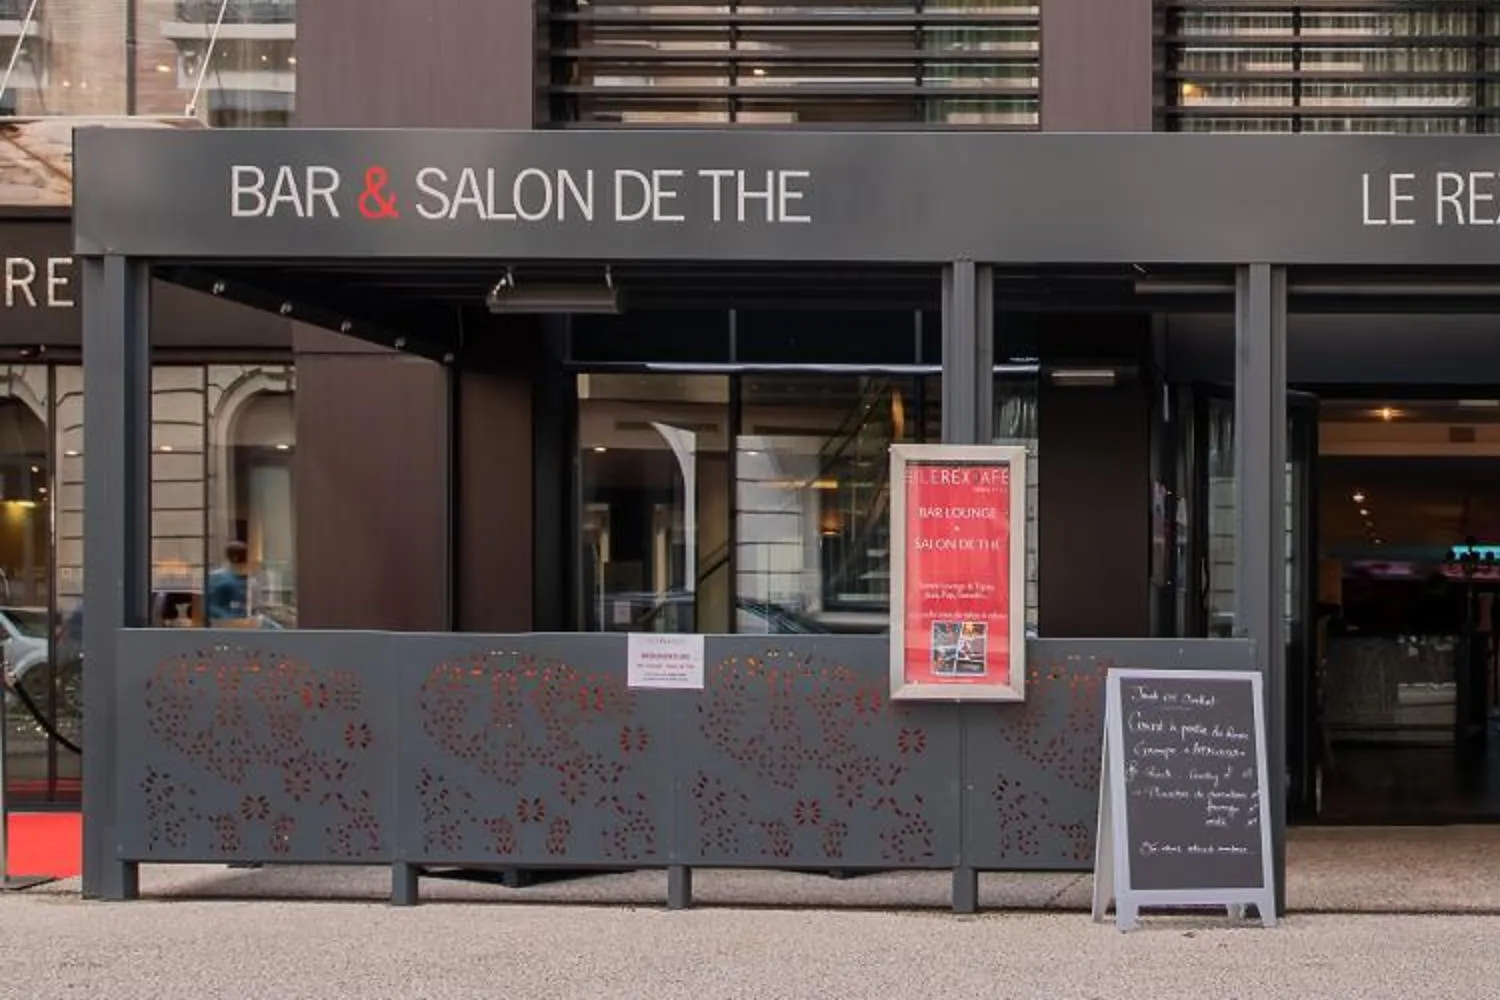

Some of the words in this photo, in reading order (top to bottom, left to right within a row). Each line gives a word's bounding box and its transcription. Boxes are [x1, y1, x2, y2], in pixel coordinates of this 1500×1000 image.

[231, 165, 340, 218] BAR
[358, 166, 398, 219] &
[415, 167, 593, 221] SALON
[615, 169, 685, 222] DE
[699, 170, 811, 223] THE
[1362, 173, 1415, 225] LE
[919, 507, 943, 519] BAR
[945, 507, 996, 520] LOUNGE
